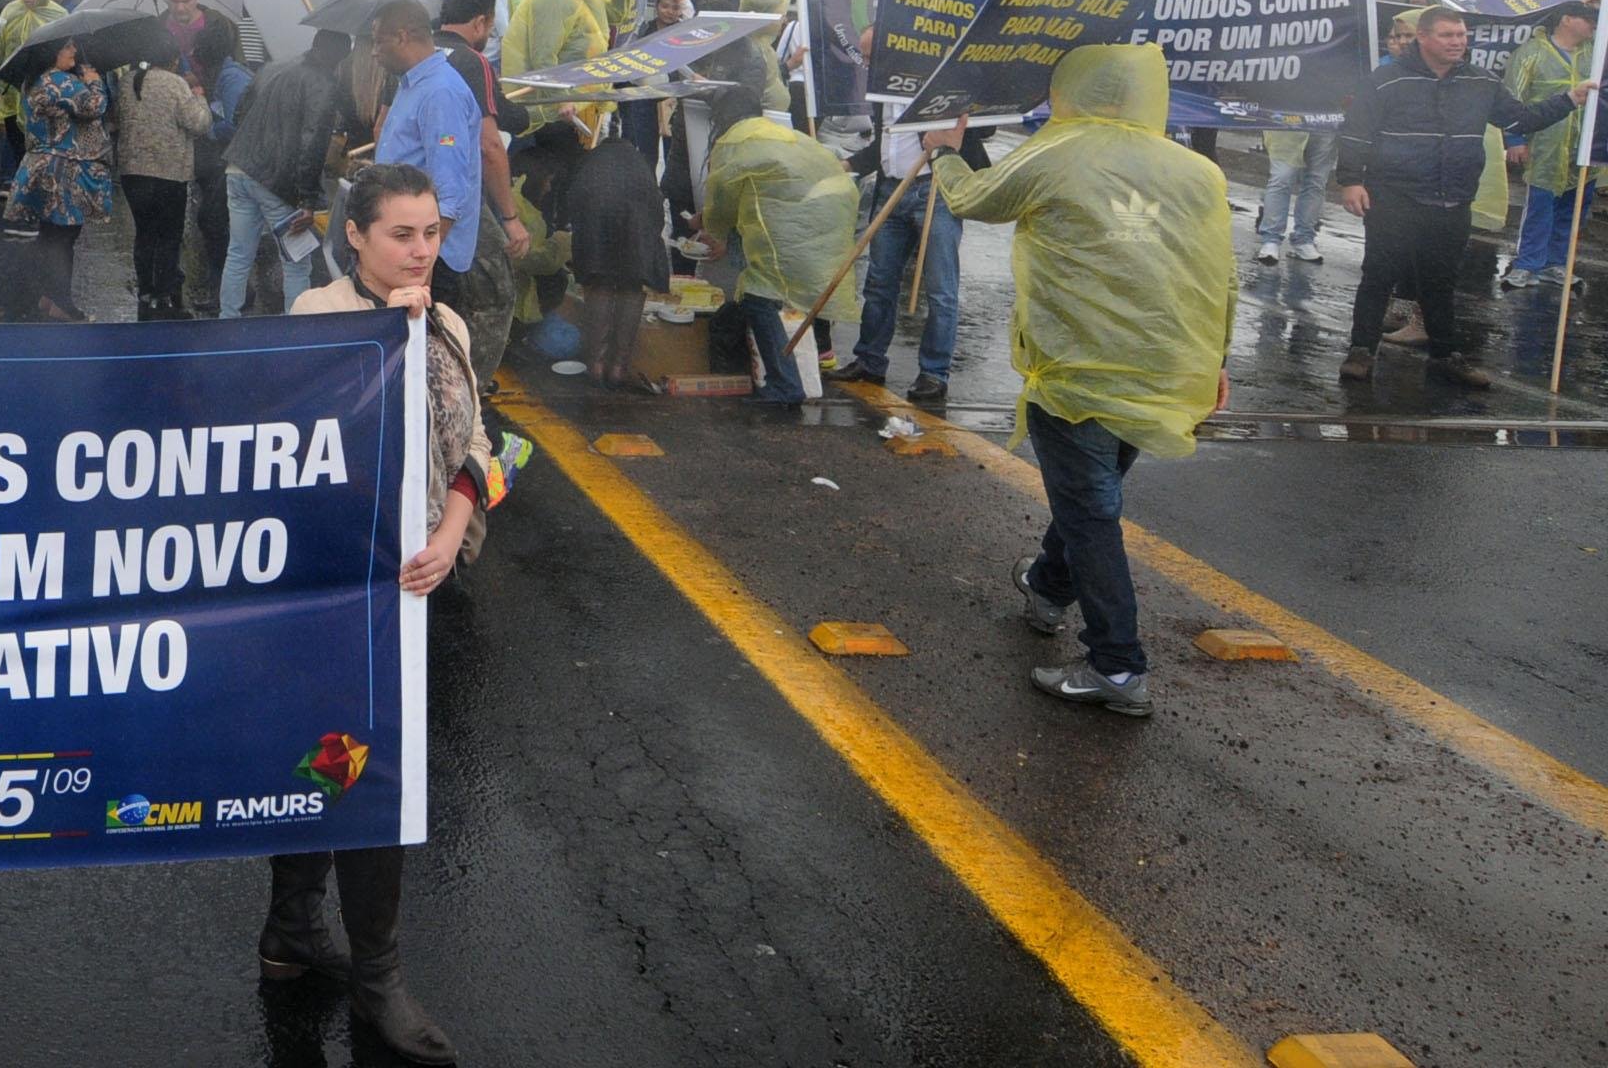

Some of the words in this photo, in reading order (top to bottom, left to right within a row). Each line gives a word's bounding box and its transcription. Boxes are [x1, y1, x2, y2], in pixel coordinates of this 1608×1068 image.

[833, 23, 849, 47] Uma
[913, 15, 956, 39] PARA
[1156, 27, 1213, 51] POR
[1219, 24, 1263, 51] UM
[1268, 18, 1334, 47] NOVO
[886, 33, 942, 57] PARAR
[55, 418, 349, 502] CONTRA
[92, 517, 288, 598] NOVO
[143, 801, 202, 825] CNM
[216, 792, 324, 821] FAMURS
